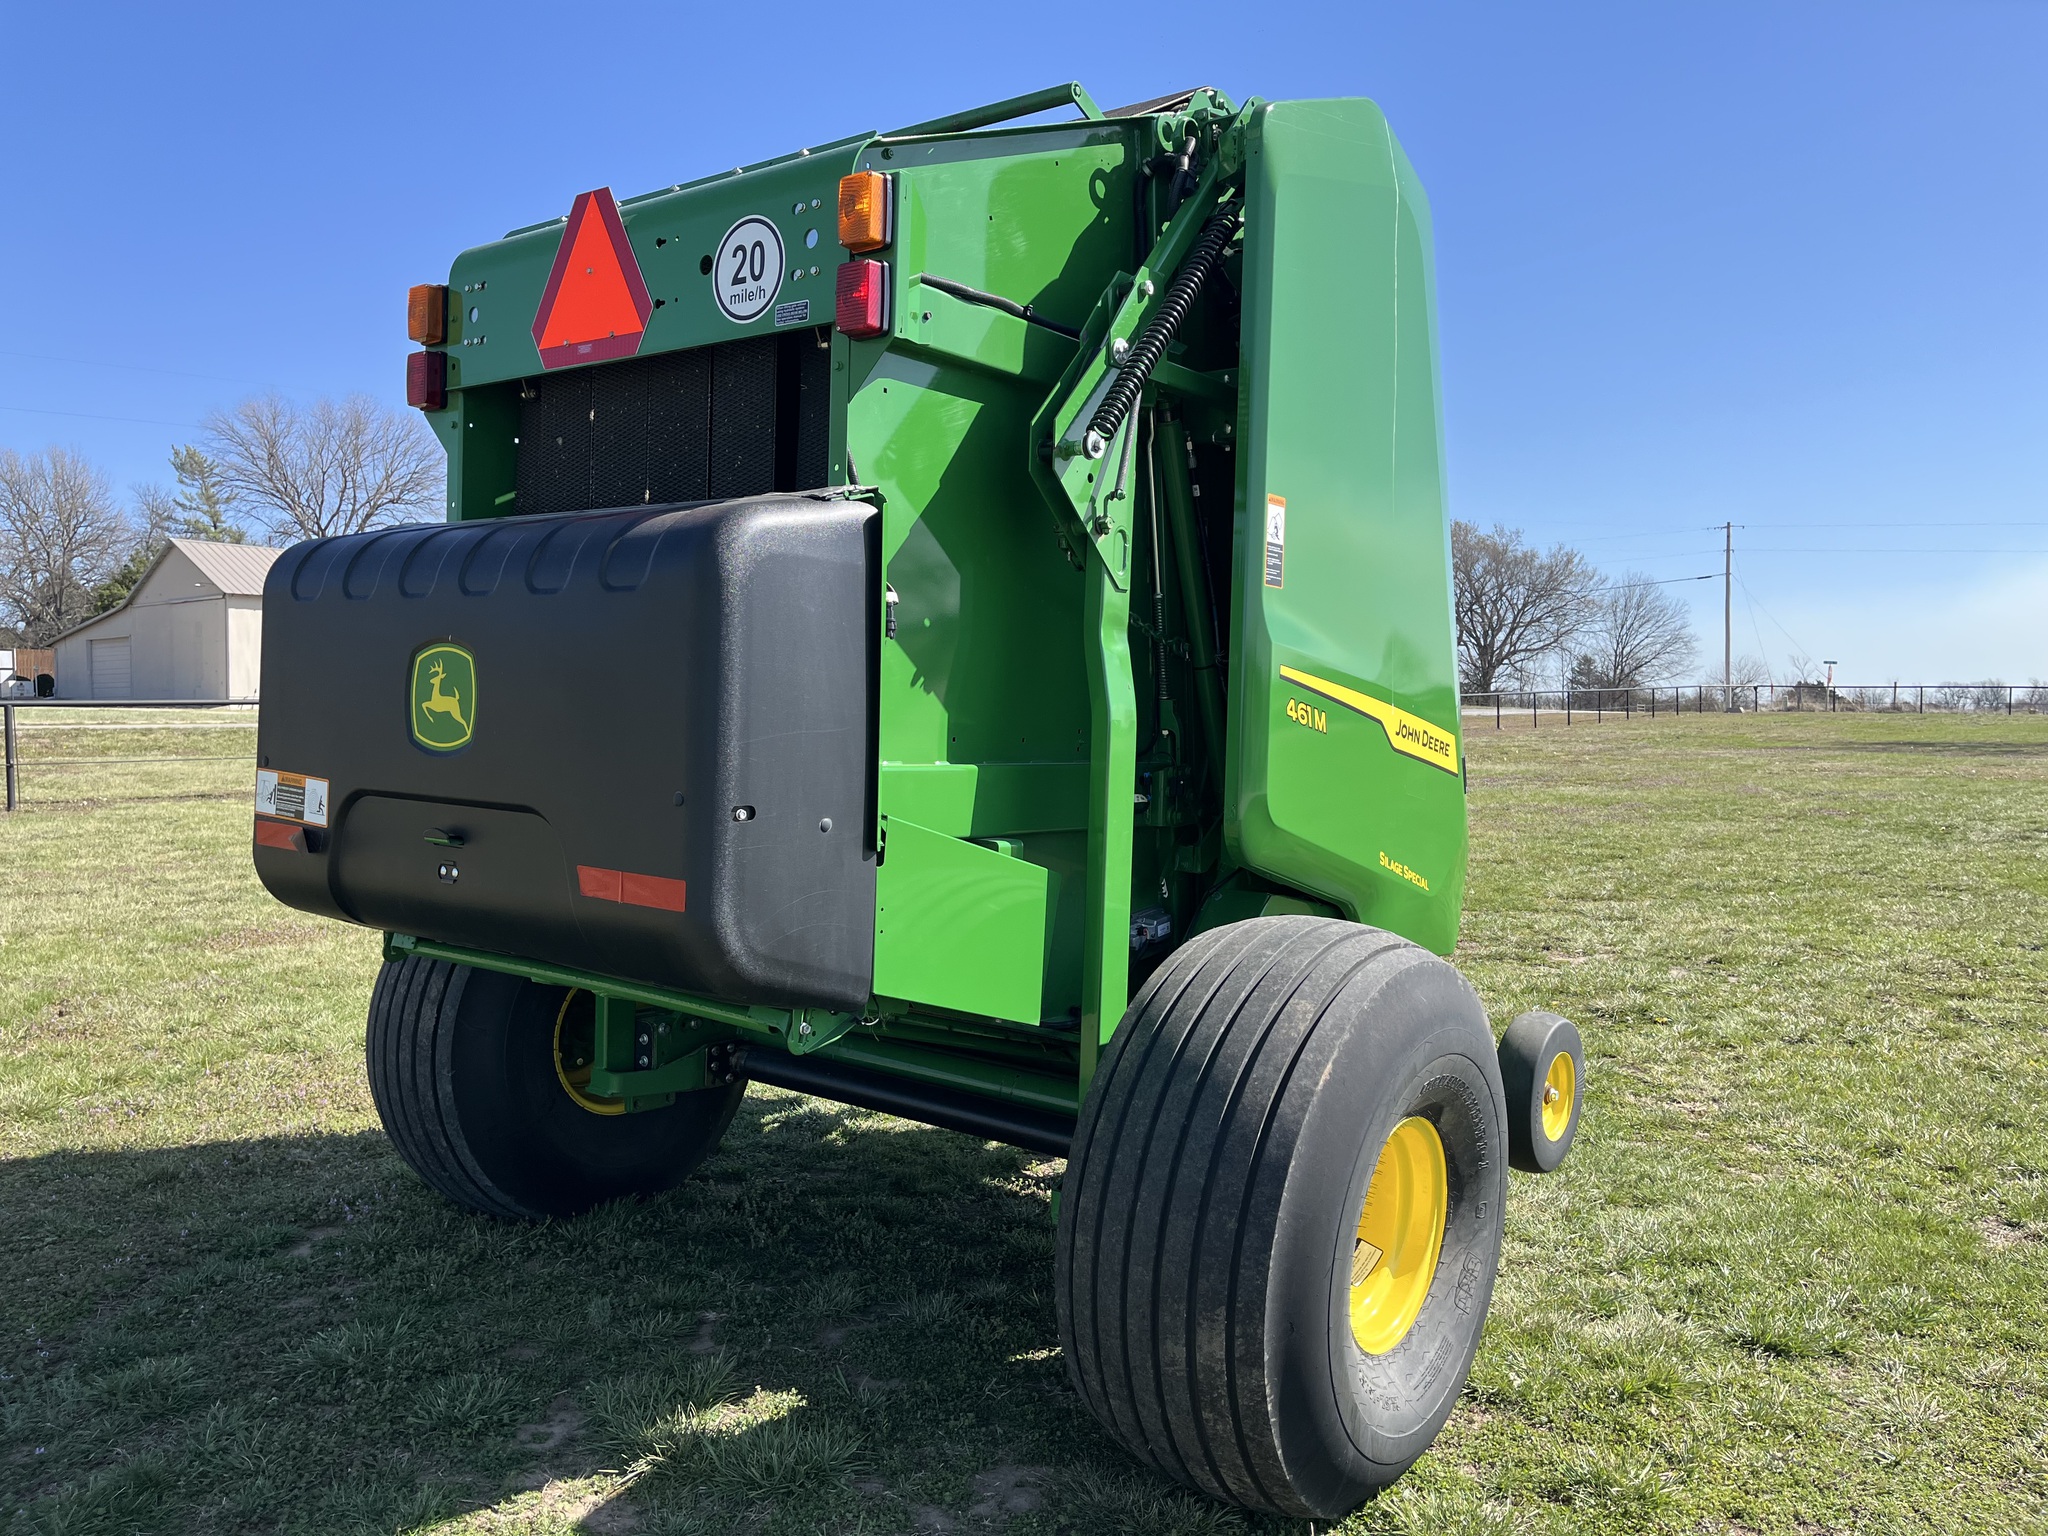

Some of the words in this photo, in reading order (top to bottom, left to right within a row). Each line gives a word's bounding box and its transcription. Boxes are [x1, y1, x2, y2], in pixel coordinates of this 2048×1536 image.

[731, 240, 765, 286] 20
[729, 285, 766, 305] mile/h
[1286, 697, 1328, 735] 461M
[1395, 719, 1420, 744] JOHN
[1421, 729, 1451, 757] DEERE
[1379, 850, 1403, 877] SILAGE
[1403, 864, 1430, 892] SPECIAL
